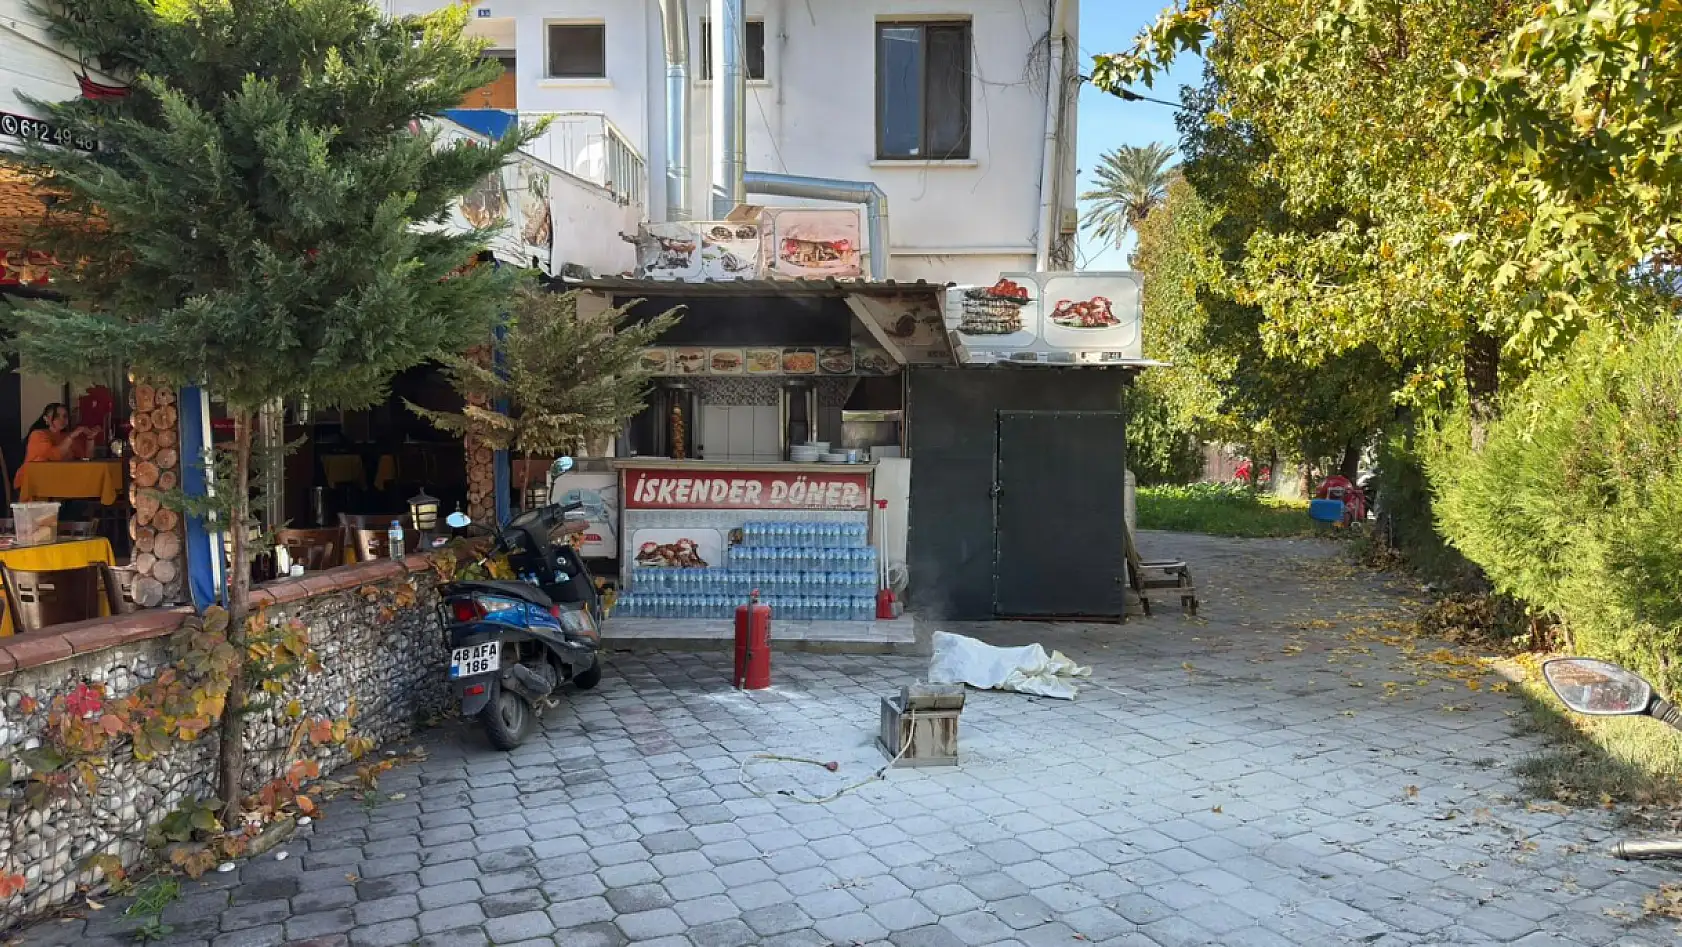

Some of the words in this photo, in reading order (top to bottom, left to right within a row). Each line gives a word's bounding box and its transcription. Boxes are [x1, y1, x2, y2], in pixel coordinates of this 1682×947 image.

[20, 119, 50, 142] 612
[53, 127, 72, 145] 49
[633, 472, 762, 505] İSKENDER
[770, 475, 861, 506] DÖNER
[454, 649, 469, 661] 48
[473, 644, 497, 659] AFA
[465, 659, 489, 673] 186
